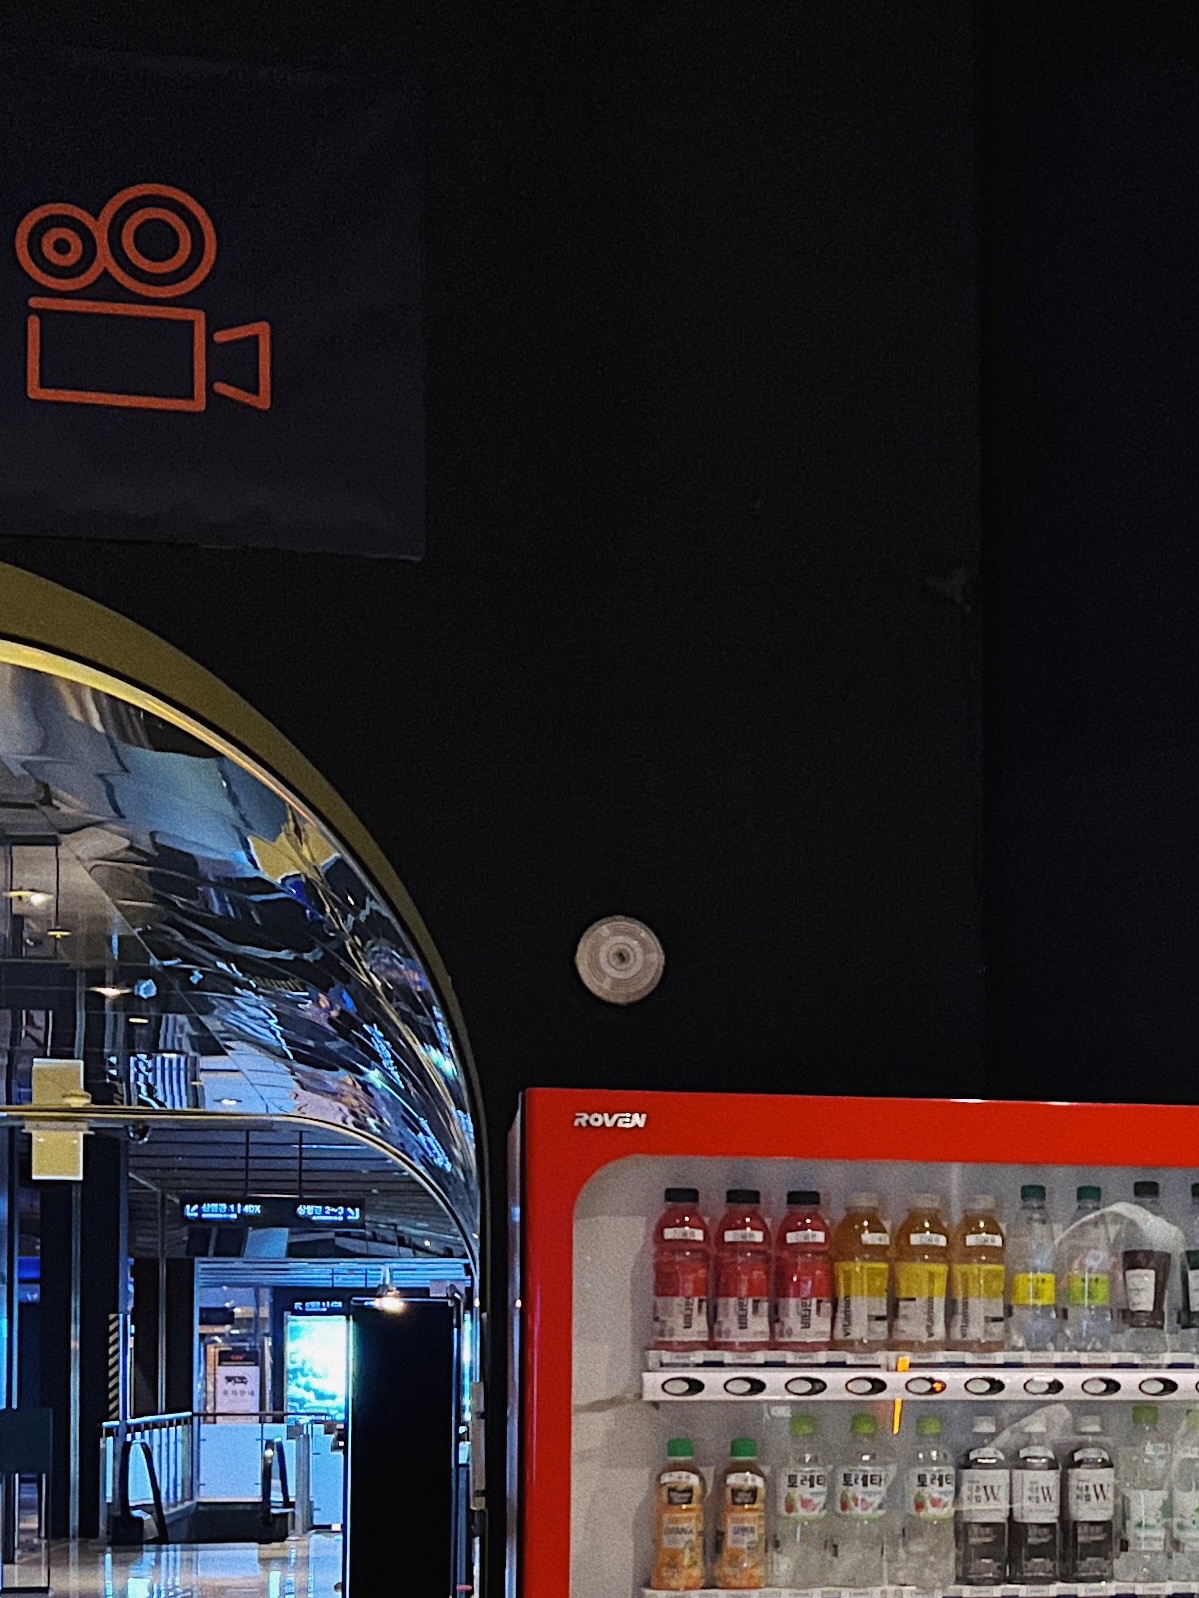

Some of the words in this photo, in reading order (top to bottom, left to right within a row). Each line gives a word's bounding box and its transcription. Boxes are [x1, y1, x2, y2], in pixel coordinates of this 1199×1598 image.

[573, 1112, 647, 1128] ROVEN
[842, 1473, 882, 1487] 토레타
[1093, 1483, 1110, 1501] W
